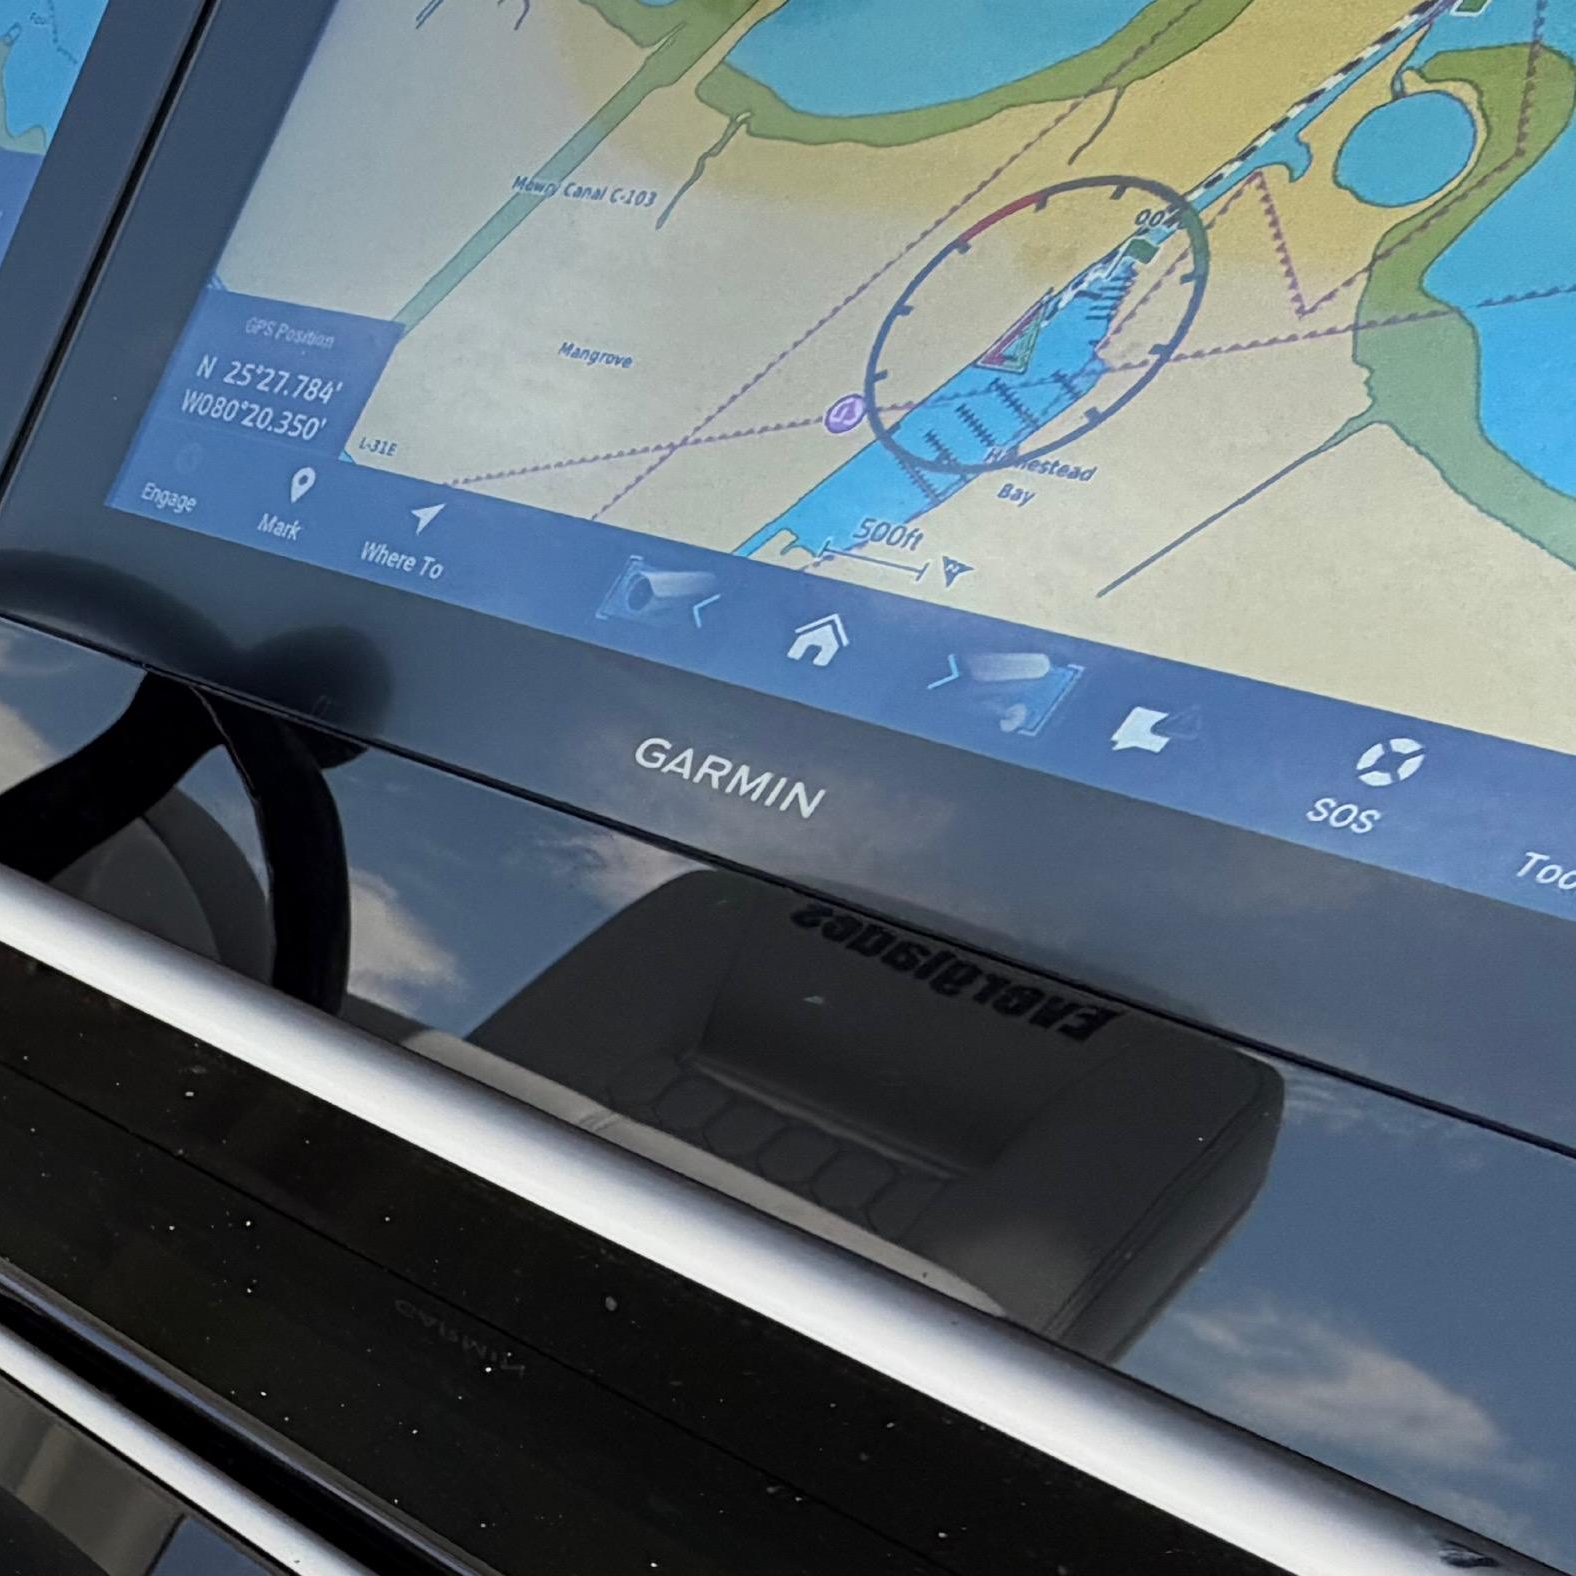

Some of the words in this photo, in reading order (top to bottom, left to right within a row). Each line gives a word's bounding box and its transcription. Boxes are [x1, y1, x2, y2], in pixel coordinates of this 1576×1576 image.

[564, 182, 607, 201] Canal
[609, 187, 658, 207] C-103
[245, 316, 274, 338] GPS
[274, 324, 335, 350] Position
[197, 353, 217, 379] N
[558, 341, 633, 368] Mangrove
[141, 481, 197, 513] Engage
[996, 482, 1036, 508] Bay
[257, 512, 302, 541] Mark
[852, 517, 925, 552] 500ft
[360, 540, 416, 572] Where
[419, 555, 445, 580] To
[634, 736, 827, 819] GARMIN
[1306, 797, 1382, 834] SOS
